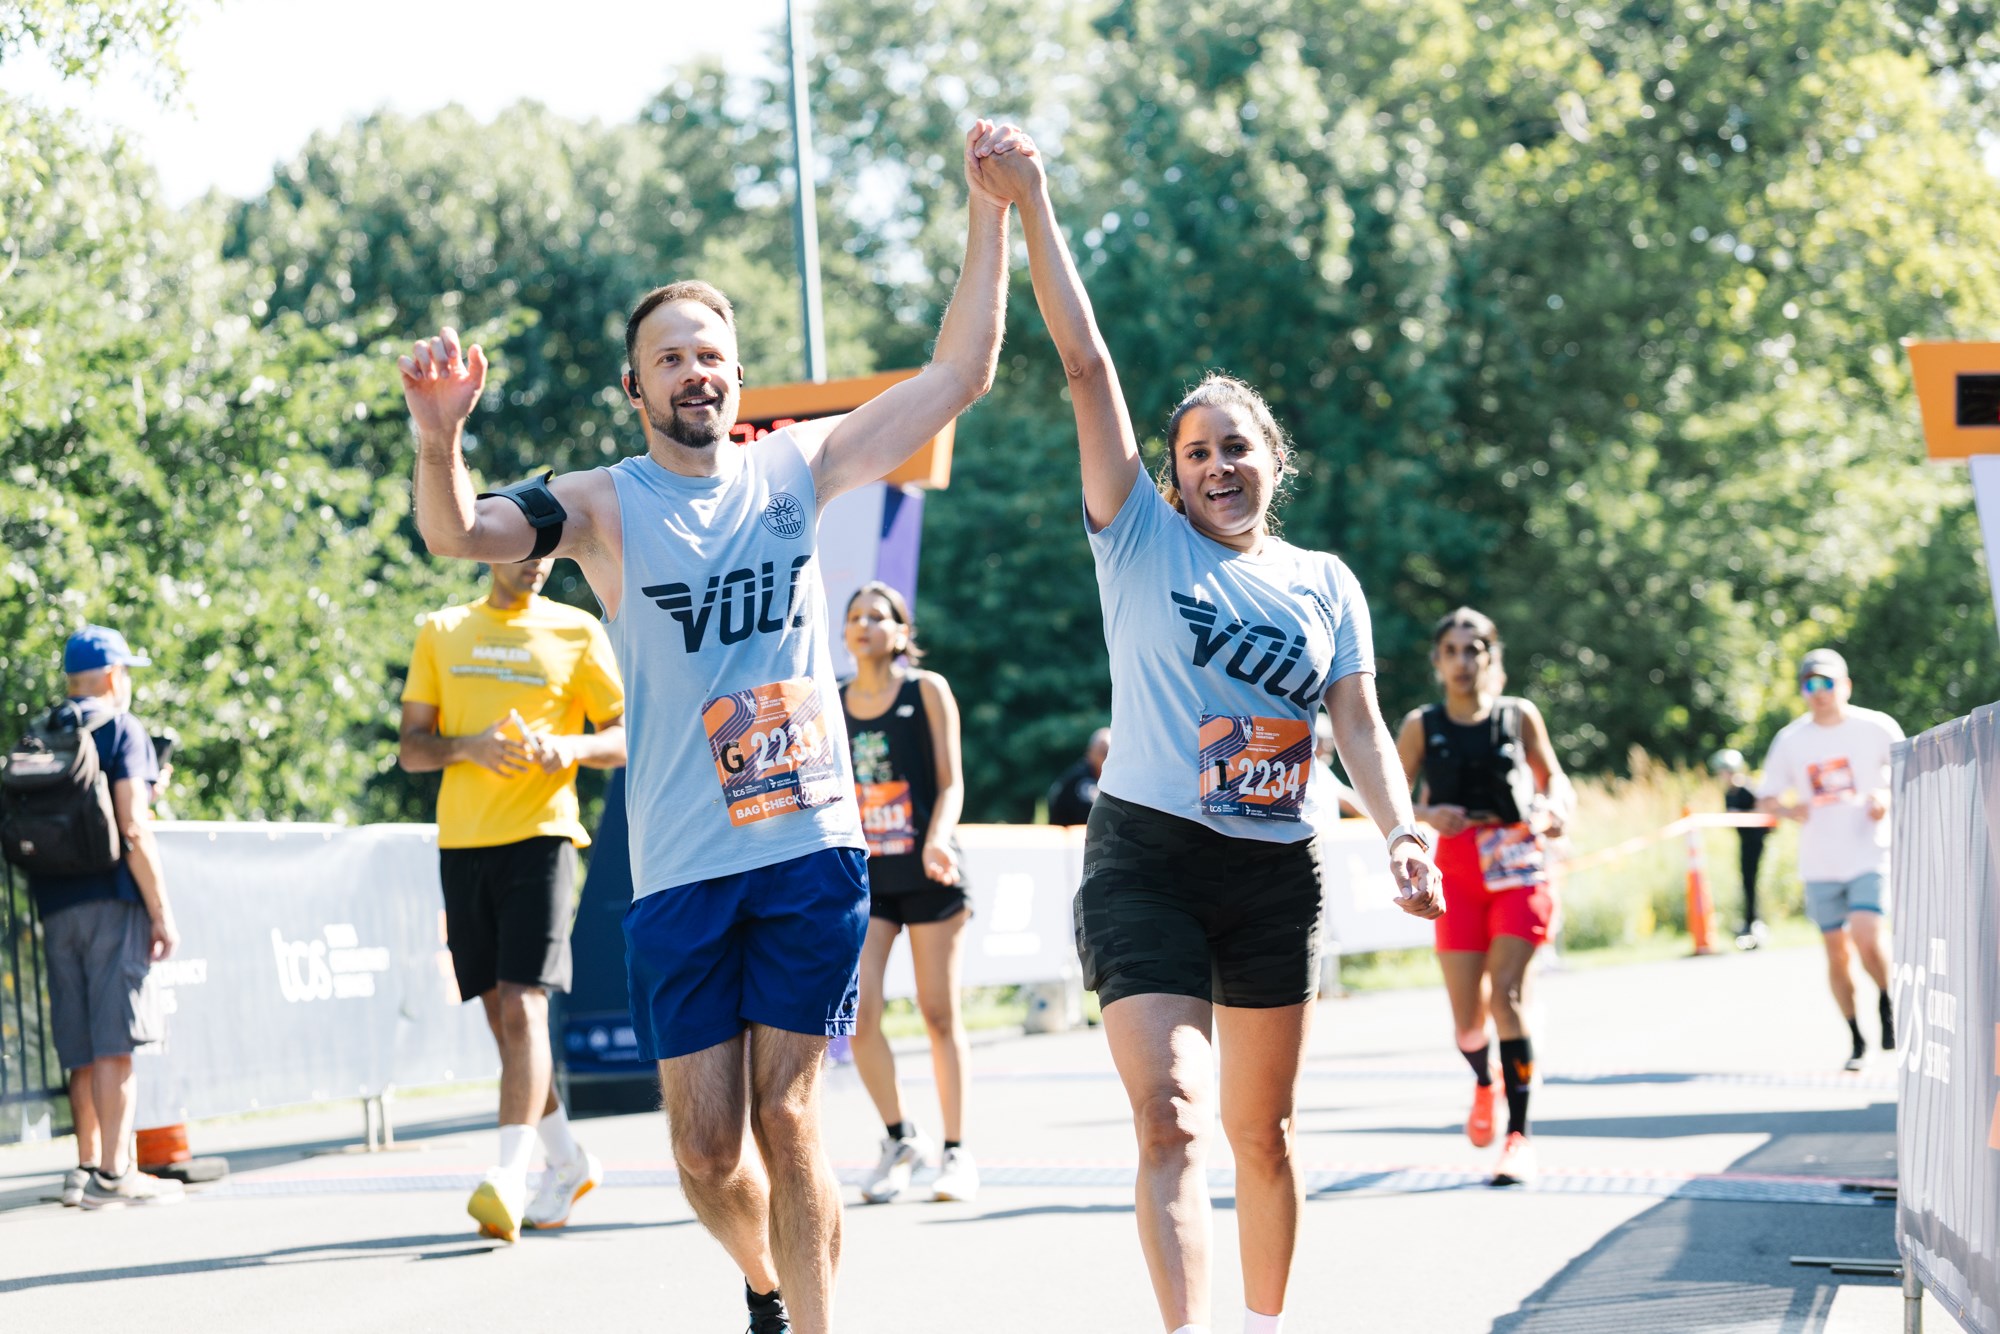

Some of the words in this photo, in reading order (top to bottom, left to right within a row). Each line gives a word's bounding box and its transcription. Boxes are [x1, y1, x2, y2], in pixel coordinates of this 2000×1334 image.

[775, 513, 796, 525] NYC
[720, 741, 745, 774] G
[751, 720, 822, 770] 2233
[1215, 759, 1232, 791] I
[1238, 758, 1301, 800] 2234
[732, 788, 746, 797] tcs
[735, 804, 761, 819] BAG
[761, 794, 802, 812] CHECK
[1209, 804, 1222, 813] tcs
